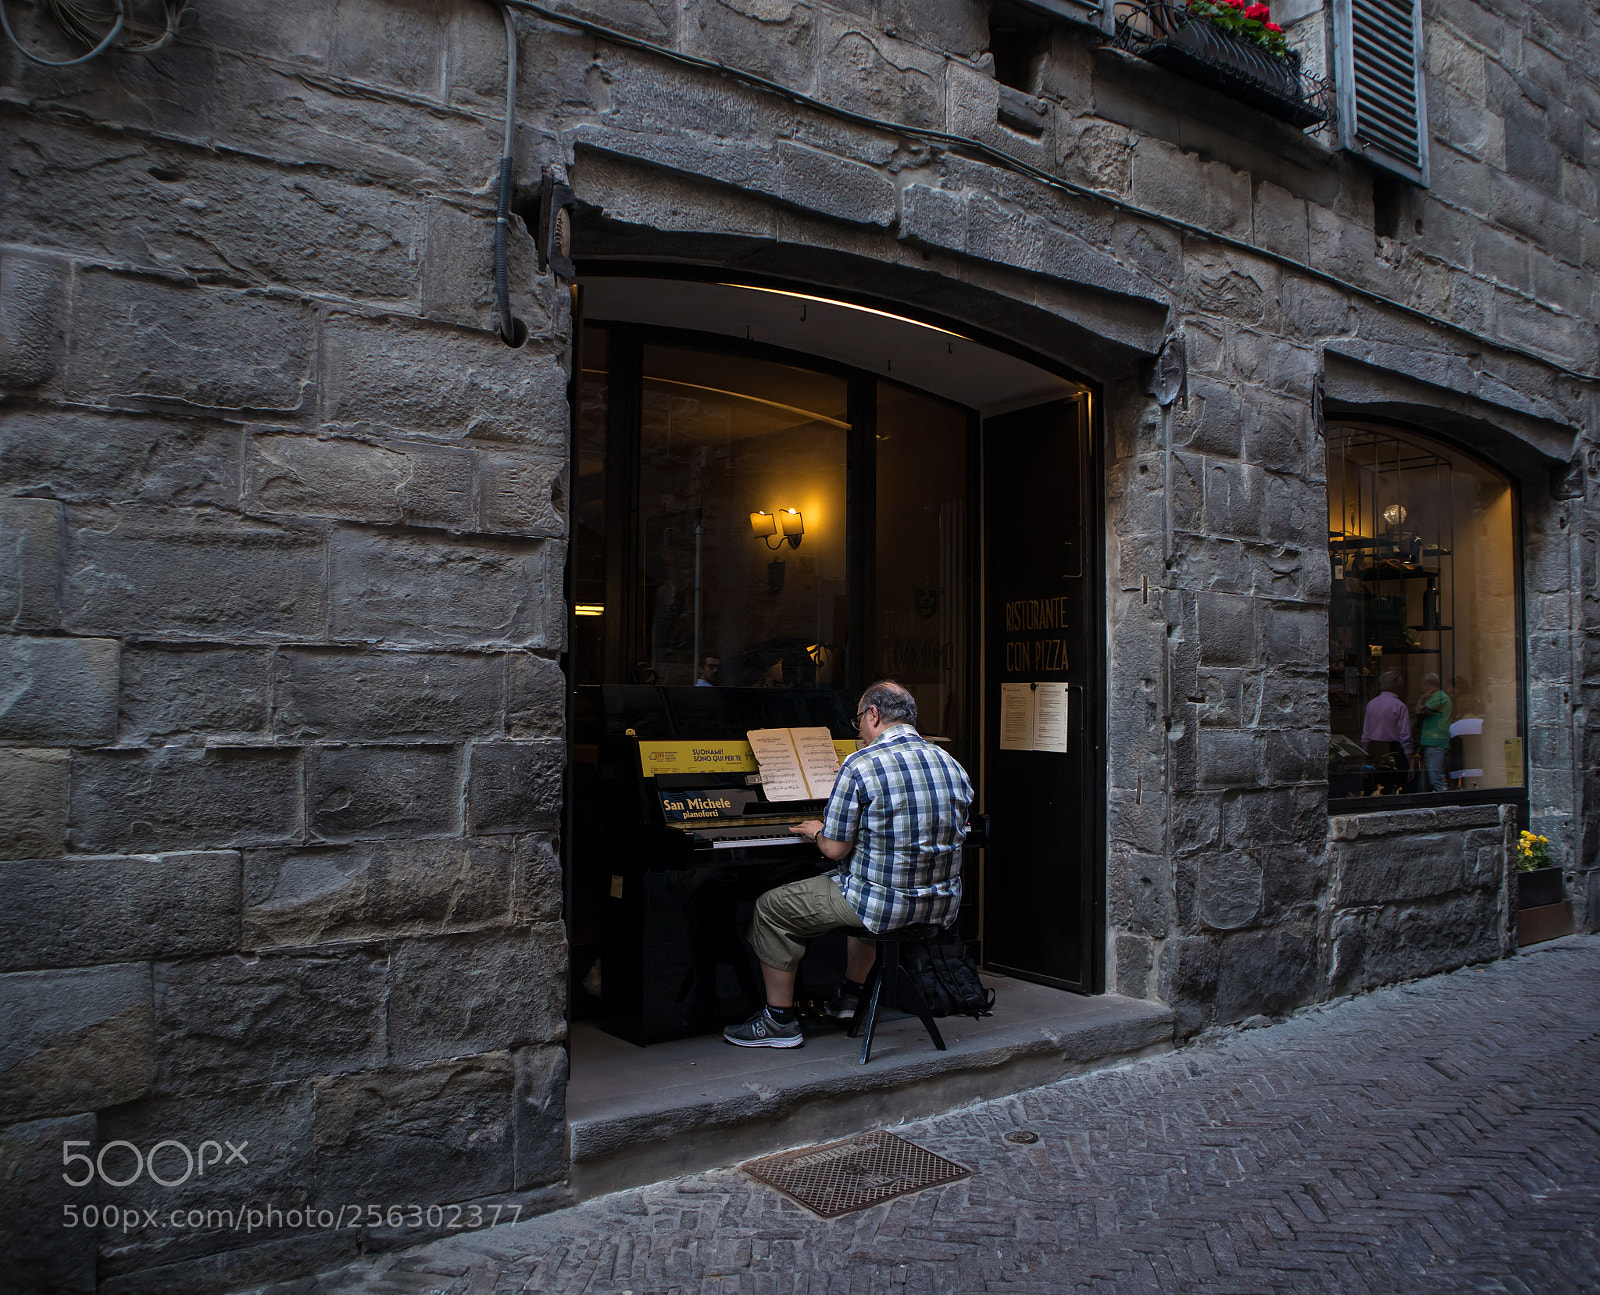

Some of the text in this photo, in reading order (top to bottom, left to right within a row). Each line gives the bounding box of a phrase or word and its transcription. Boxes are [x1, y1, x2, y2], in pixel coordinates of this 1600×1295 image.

[1005, 596, 1069, 632] RISTORANTE
[1006, 639, 1069, 672] CON PIZZA
[735, 754, 742, 762] TE
[663, 797, 732, 811] San Michele
[682, 809, 719, 820] pianoforti
